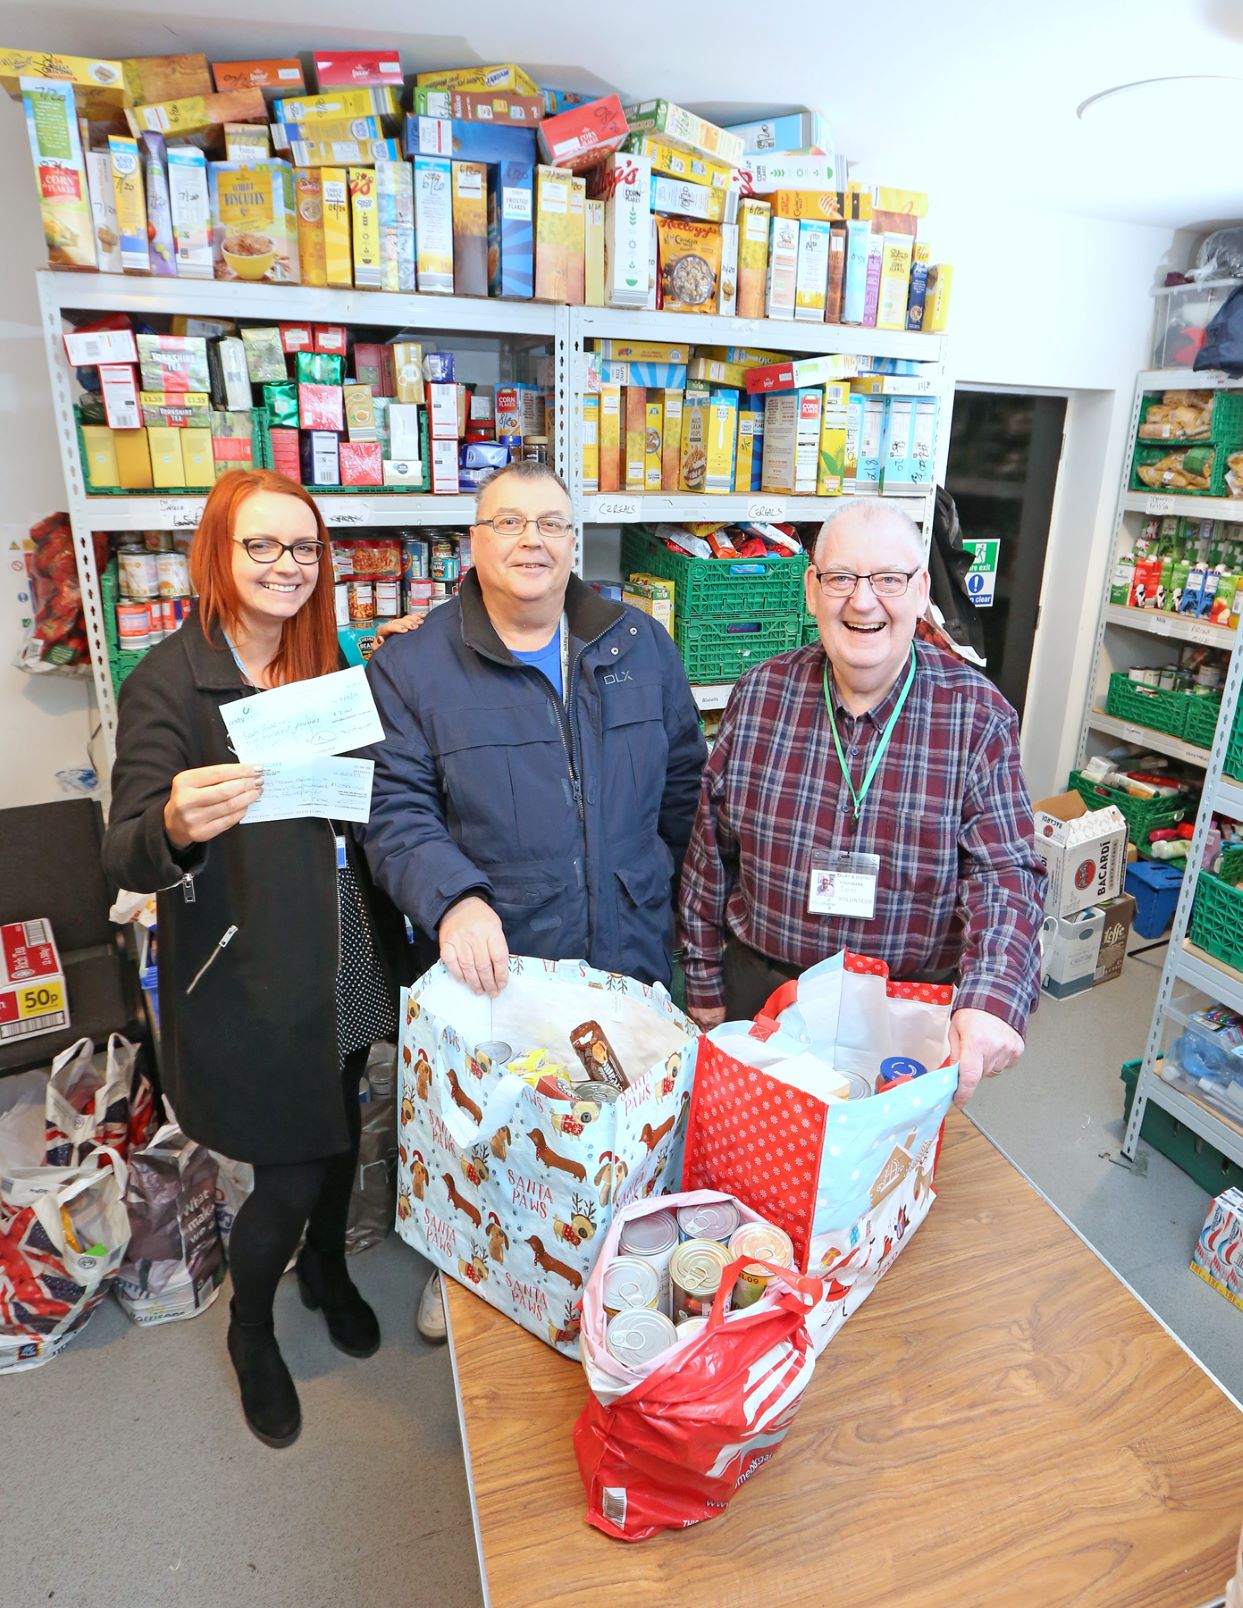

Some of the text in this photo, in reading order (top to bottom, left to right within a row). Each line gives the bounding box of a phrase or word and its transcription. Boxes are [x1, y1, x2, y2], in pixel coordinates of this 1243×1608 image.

[506, 197, 529, 205] FROSTED
[151, 350, 196, 361] YORKSHIRE
[167, 362, 182, 371] TEA
[160, 407, 193, 416] YORKSHIRE
[598, 503, 636, 514] CEREALS
[748, 504, 783, 518] CEREALS
[604, 671, 632, 685] DLX
[1097, 840, 1111, 896] BACARDÍ
[24, 988, 59, 1009] 50p
[442, 1028, 461, 1052] AWS
[507, 1168, 553, 1205] SANTA
[512, 1189, 548, 1219] PAWS
[424, 1208, 457, 1245] SANTA
[426, 1230, 453, 1258] PAWS
[505, 1272, 549, 1310] SANTA
[511, 1289, 543, 1322] PAWS
